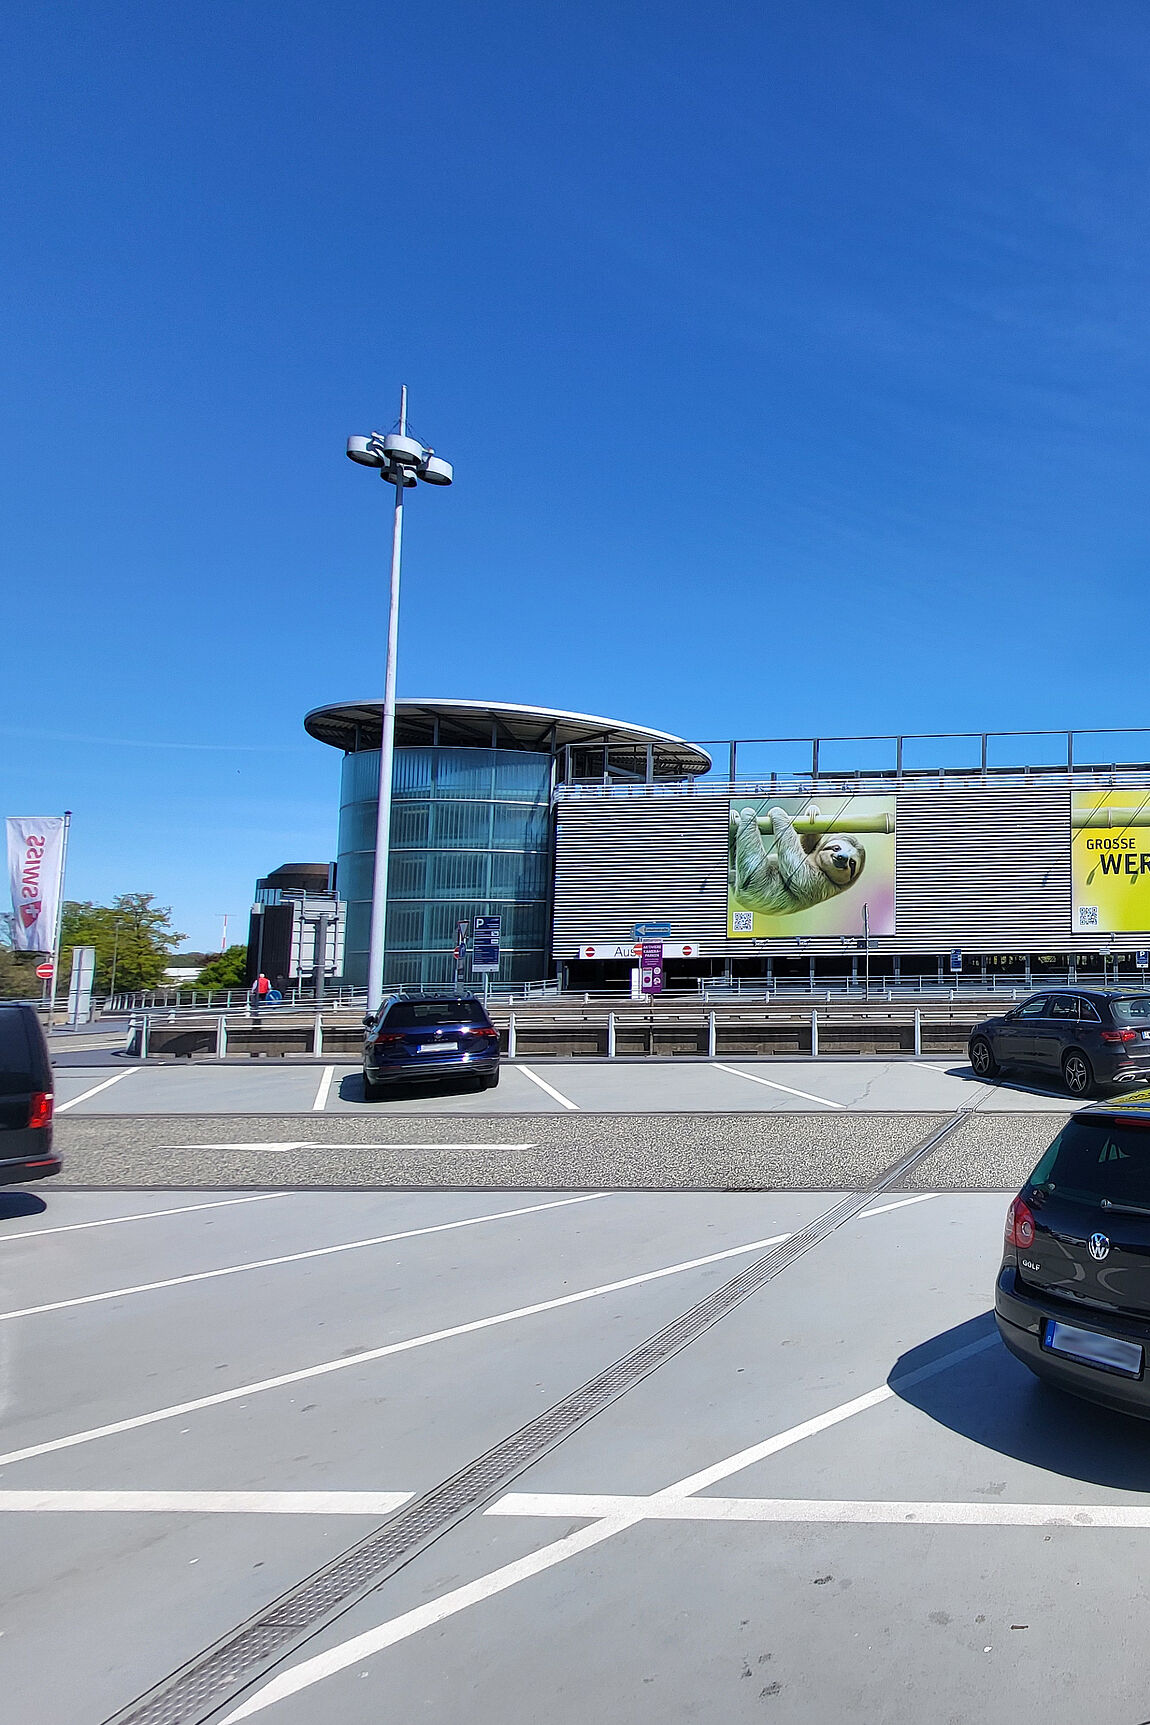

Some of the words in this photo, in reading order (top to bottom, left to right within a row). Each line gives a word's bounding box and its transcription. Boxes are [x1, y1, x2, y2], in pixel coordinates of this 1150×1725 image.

[1086, 838, 1136, 850] GROSSE
[476, 918, 484, 928] P
[614, 947, 637, 957] Aus
[1022, 1259, 1041, 1271] GOLF
